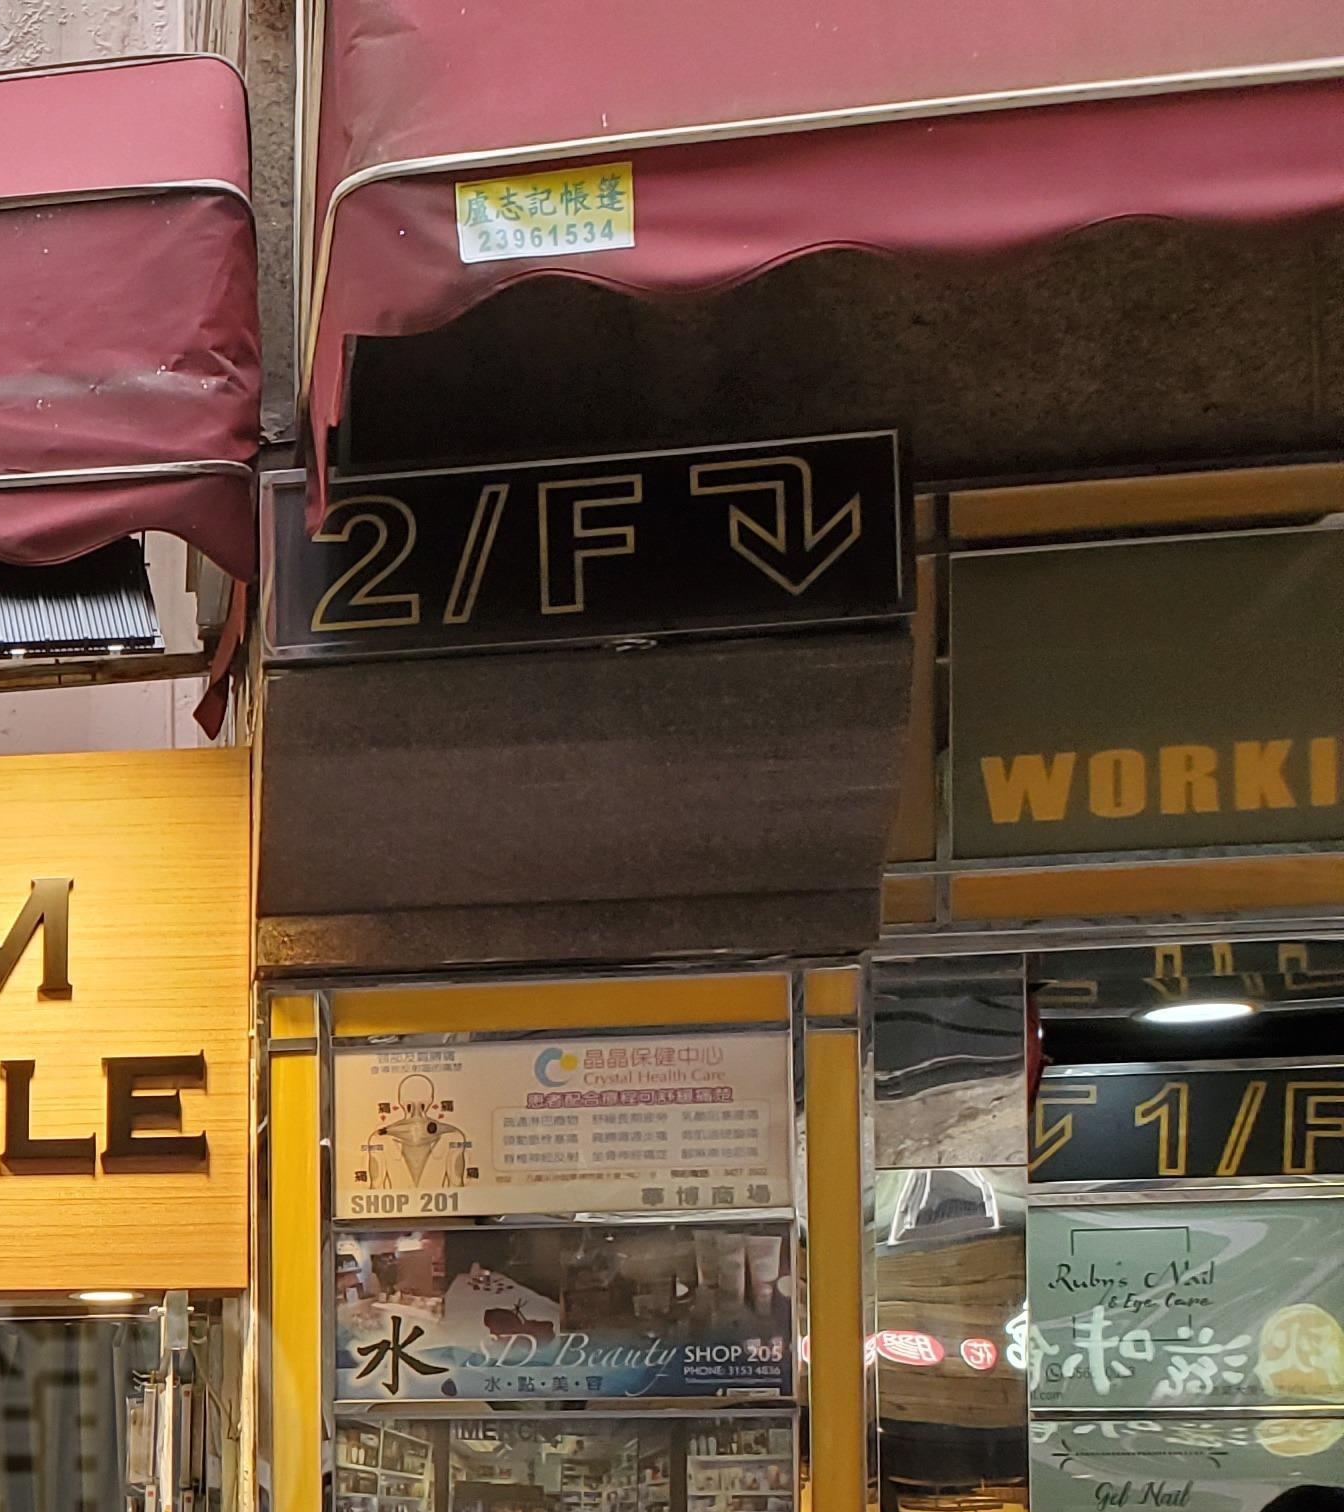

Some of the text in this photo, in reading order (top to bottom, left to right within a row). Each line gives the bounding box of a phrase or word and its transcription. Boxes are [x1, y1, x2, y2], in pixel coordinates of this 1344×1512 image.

[478, 219, 614, 252] 23961534
[311, 473, 644, 632] 2/F
[583, 1047, 724, 1069] 晶晶保健中心
[584, 1069, 726, 1085] Crystal Health Care
[351, 1192, 459, 1214] SHOP 201
[1144, 1260, 1214, 1287] Nail
[356, 1315, 450, 1395] 水
[553, 1332, 678, 1397] Beauty
[683, 1345, 783, 1363] SHOP 205
[1094, 1480, 1193, 1511] Gel Nail
